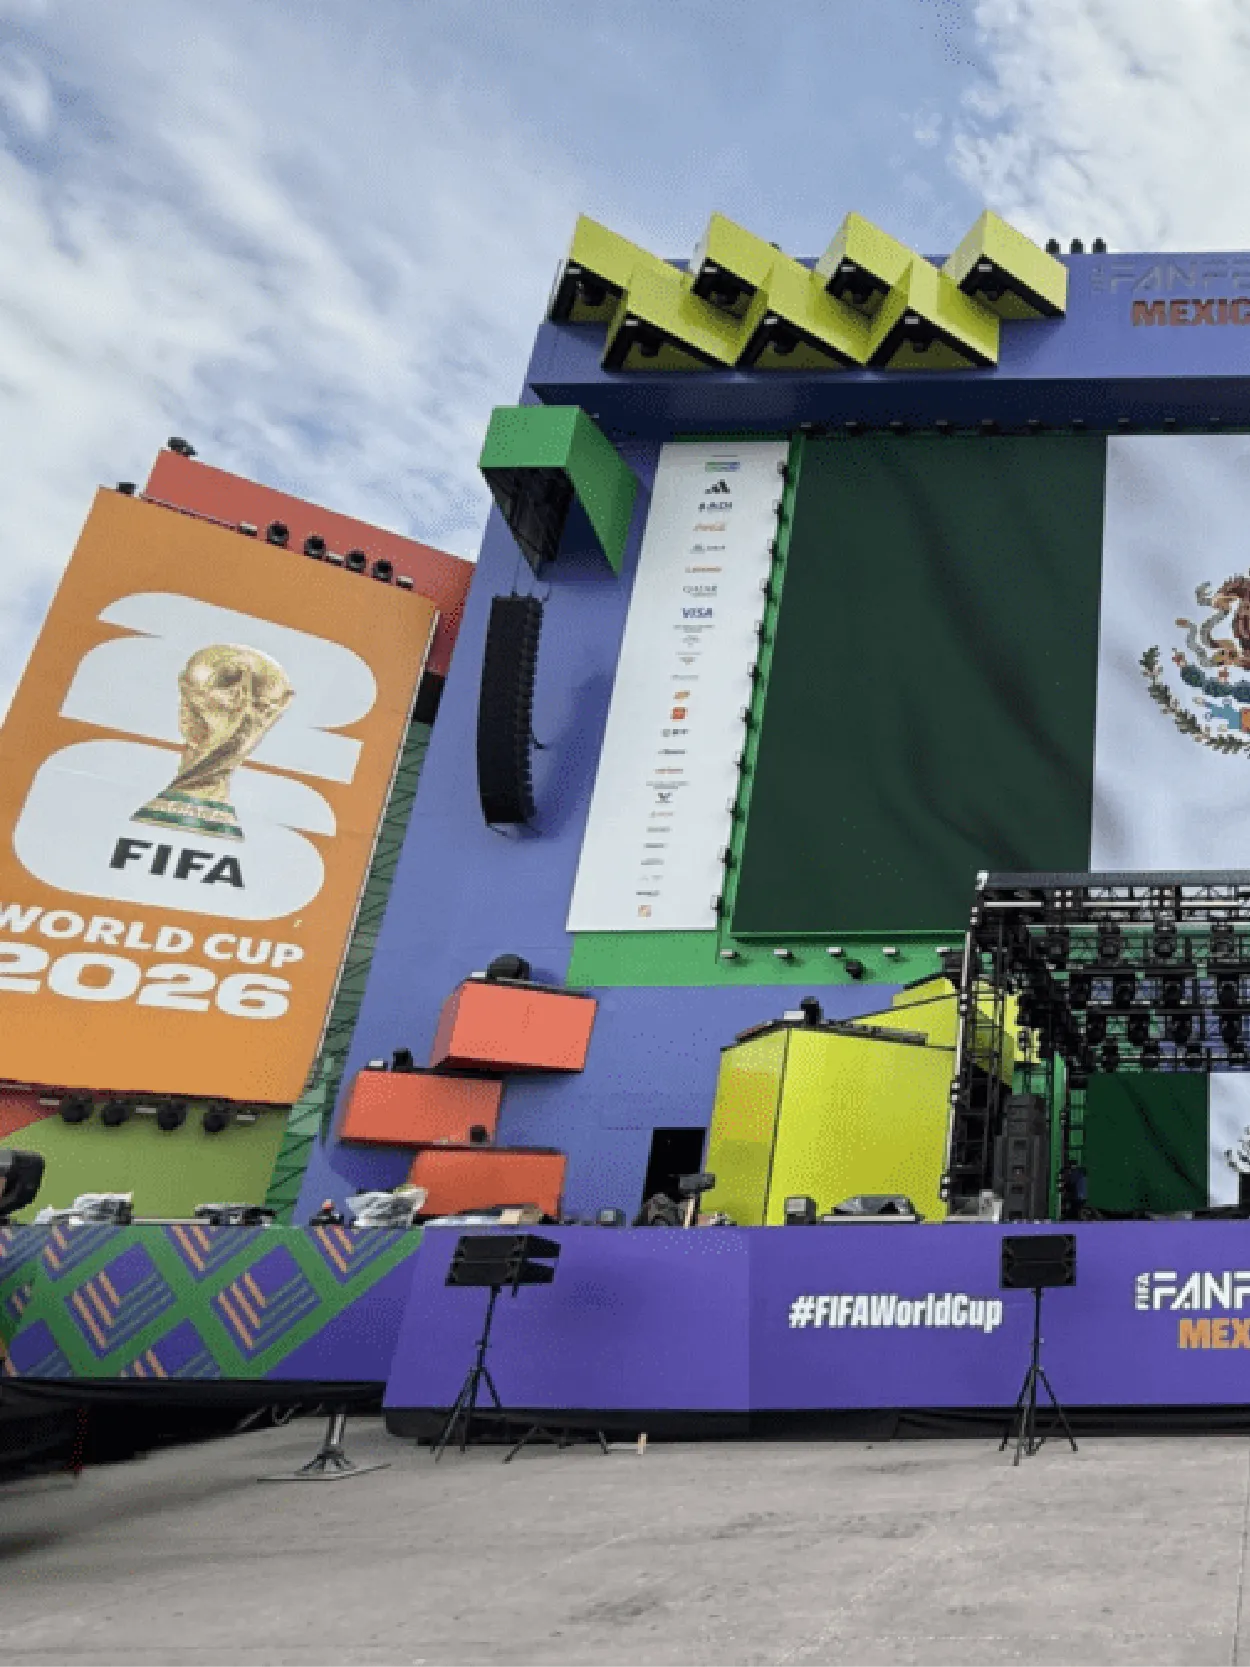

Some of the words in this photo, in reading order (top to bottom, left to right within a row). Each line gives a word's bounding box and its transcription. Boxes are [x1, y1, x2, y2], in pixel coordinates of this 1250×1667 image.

[109, 837, 245, 888] FIFA
[0, 904, 194, 953] WORLD
[203, 932, 304, 967] CUP
[0, 941, 292, 1020] 2026
[788, 1293, 1003, 1333] #FIFAWorldCup
